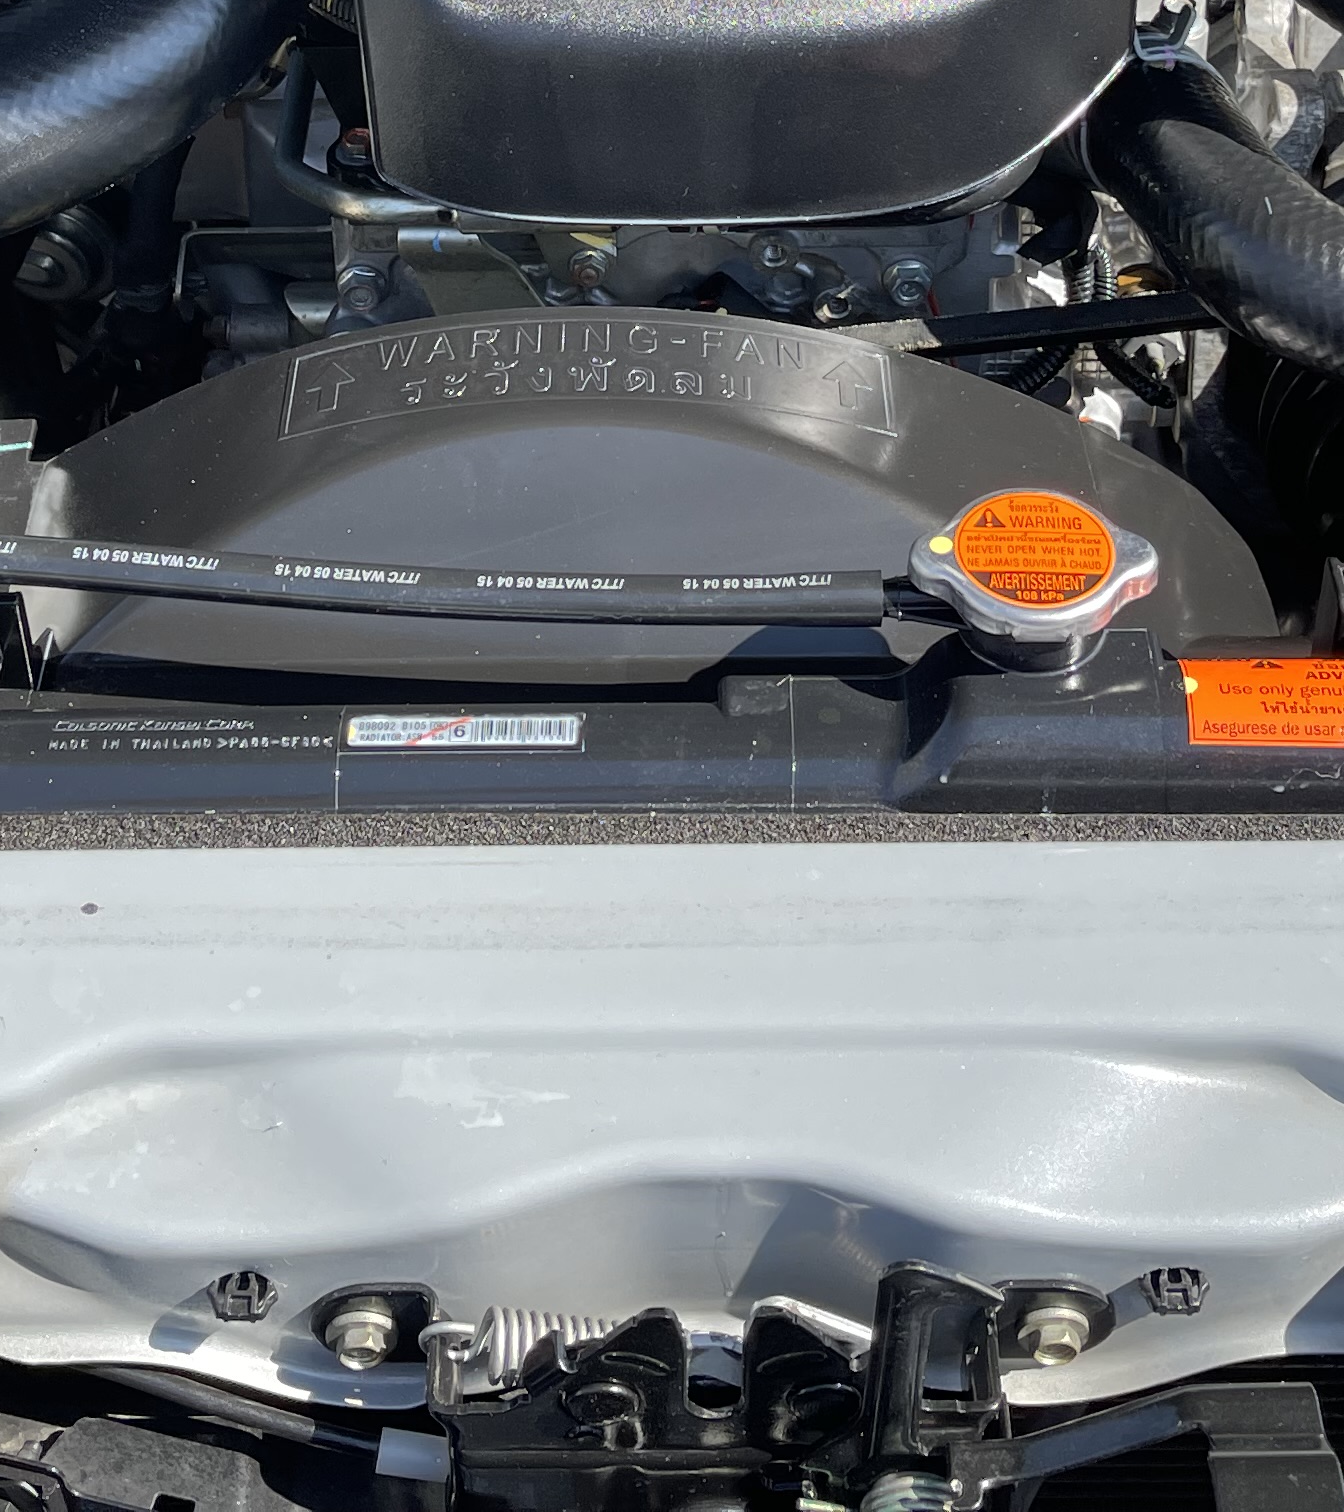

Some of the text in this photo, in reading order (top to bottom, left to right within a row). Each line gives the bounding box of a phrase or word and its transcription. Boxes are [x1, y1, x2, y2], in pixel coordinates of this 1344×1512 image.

[400, 356, 754, 404] ระวังพัดลม
[1009, 515, 1082, 530] WARNING
[72, 546, 89, 559] 15
[92, 548, 109, 561] 04
[112, 549, 129, 563] 05
[967, 545, 1002, 554] NEVER
[1007, 545, 1036, 555] OPEN
[1041, 546, 1074, 556] WHEN
[132, 551, 184, 568] WATER
[967, 557, 980, 567] NE
[983, 558, 1019, 567] JAMAIS
[1022, 558, 1057, 568] OUVRIR
[275, 563, 292, 577] 15
[295, 565, 311, 578] 04
[314, 566, 330, 579] 05
[333, 567, 385, 583] WATER
[477, 575, 494, 588] 15
[497, 575, 514, 588] 04
[517, 576, 533, 588] 05
[536, 577, 589, 589] WATER
[683, 578, 699, 590] 15
[703, 578, 720, 590] 04
[723, 578, 740, 590] 05
[743, 576, 797, 588] WATER
[989, 572, 1087, 591] AVERTISSEMENT
[1041, 590, 1065, 601] kPa
[1219, 683, 1253, 695] Use
[1259, 683, 1294, 698] only
[454, 725, 465, 737] 6
[1202, 719, 1277, 738] Asegurese
[1282, 722, 1300, 736] de
[1304, 724, 1336, 736] usar
[48, 739, 89, 750] MADE
[102, 738, 120, 750] IN
[132, 738, 212, 750] THAILAND
